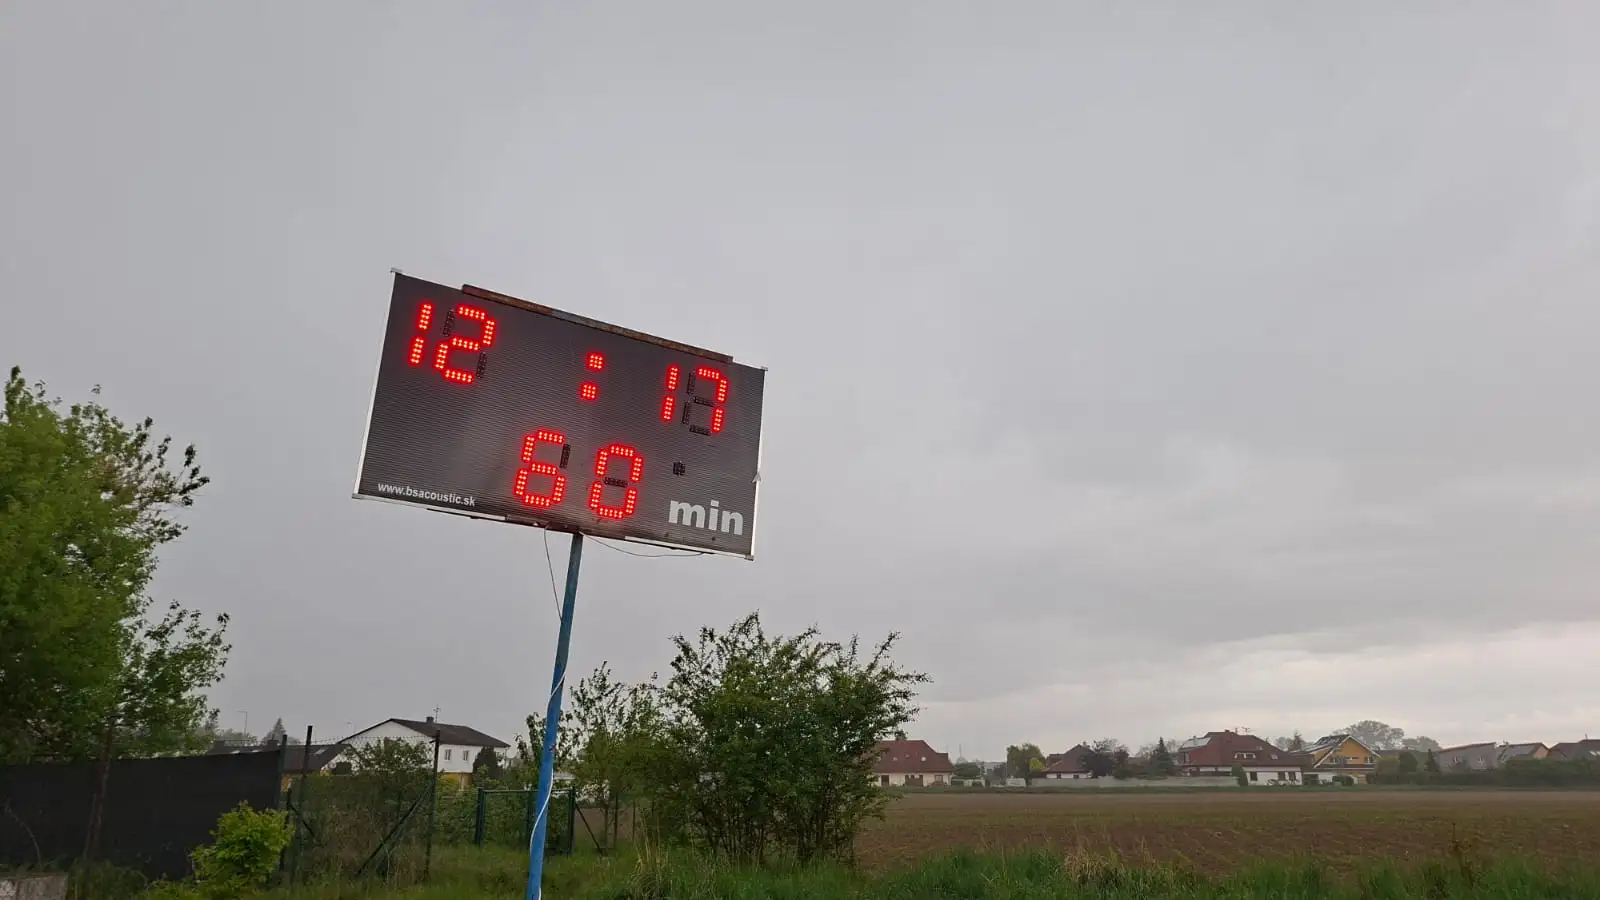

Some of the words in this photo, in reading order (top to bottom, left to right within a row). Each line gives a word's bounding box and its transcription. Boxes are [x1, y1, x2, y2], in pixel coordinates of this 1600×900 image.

[408, 301, 496, 384] 12
[661, 364, 729, 434] 17
[377, 483, 476, 507] www.bsacoustic.sk
[512, 428, 643, 519] 60
[668, 499, 744, 536] min
